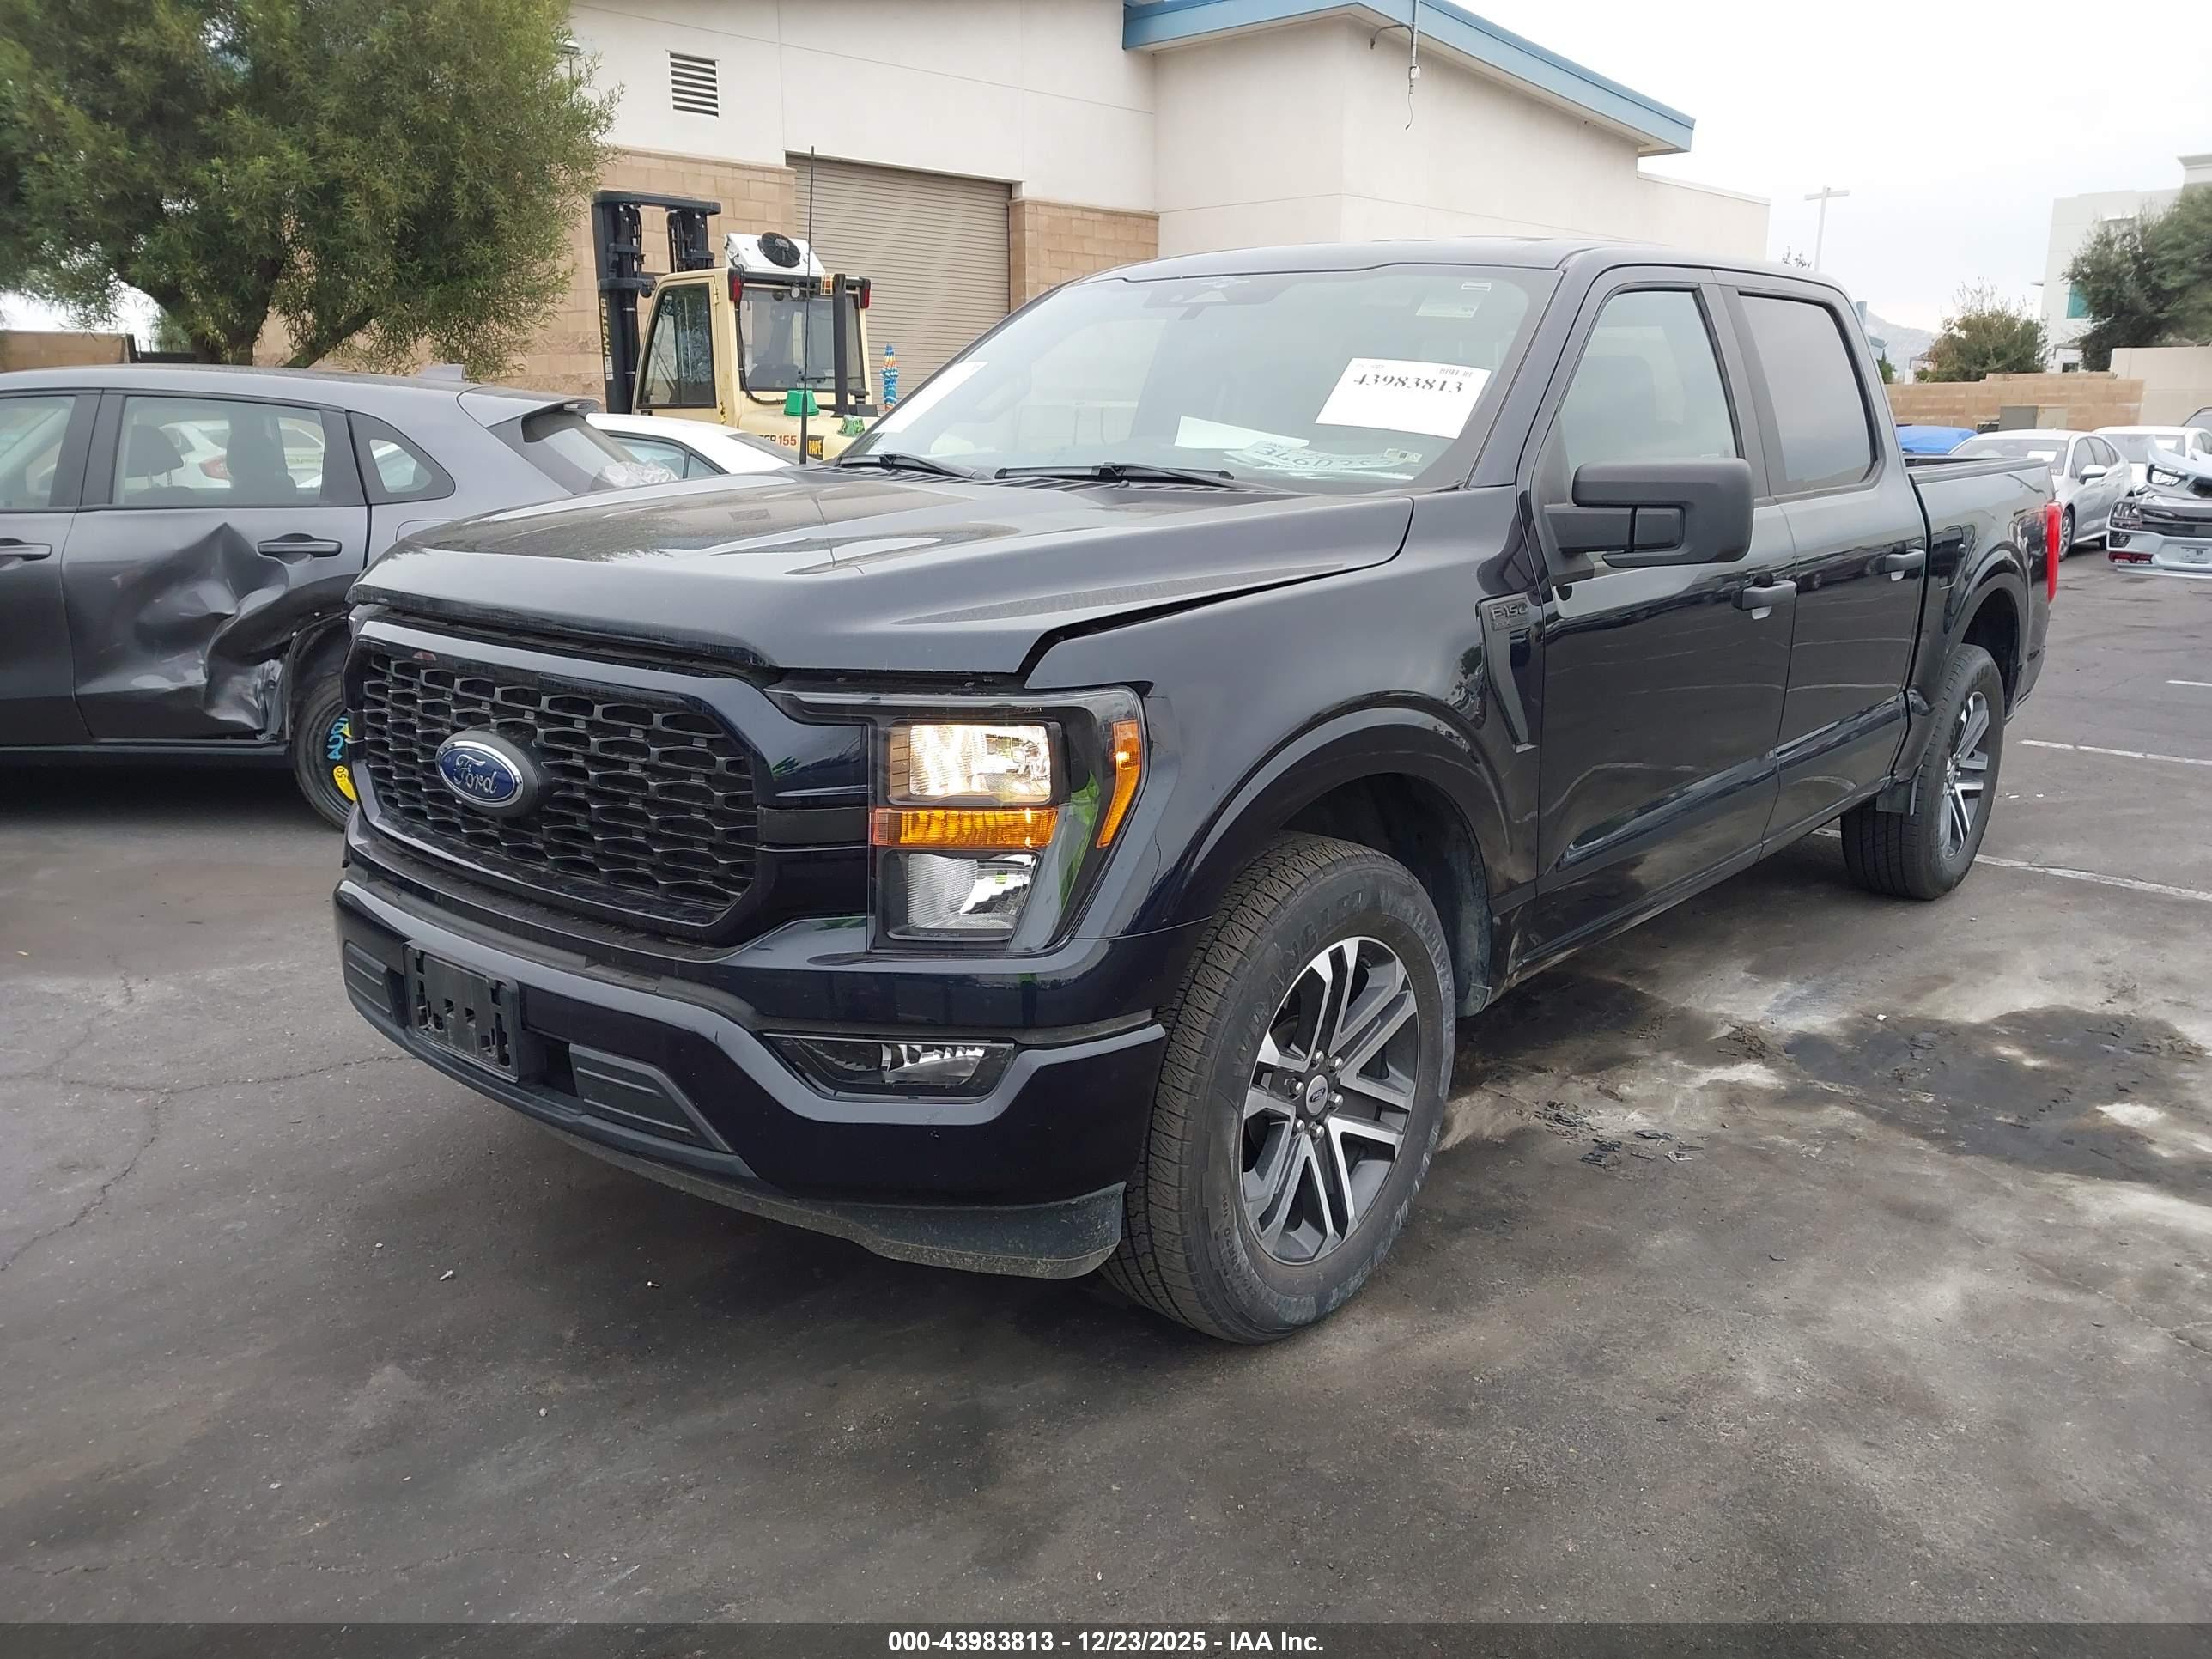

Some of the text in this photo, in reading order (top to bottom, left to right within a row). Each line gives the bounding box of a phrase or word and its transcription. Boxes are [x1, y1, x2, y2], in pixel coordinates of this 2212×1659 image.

[600, 297, 611, 355] HYSTER
[1353, 374, 1463, 393] 43983813
[779, 435, 798, 446] 155
[453, 754, 497, 794] Ford
